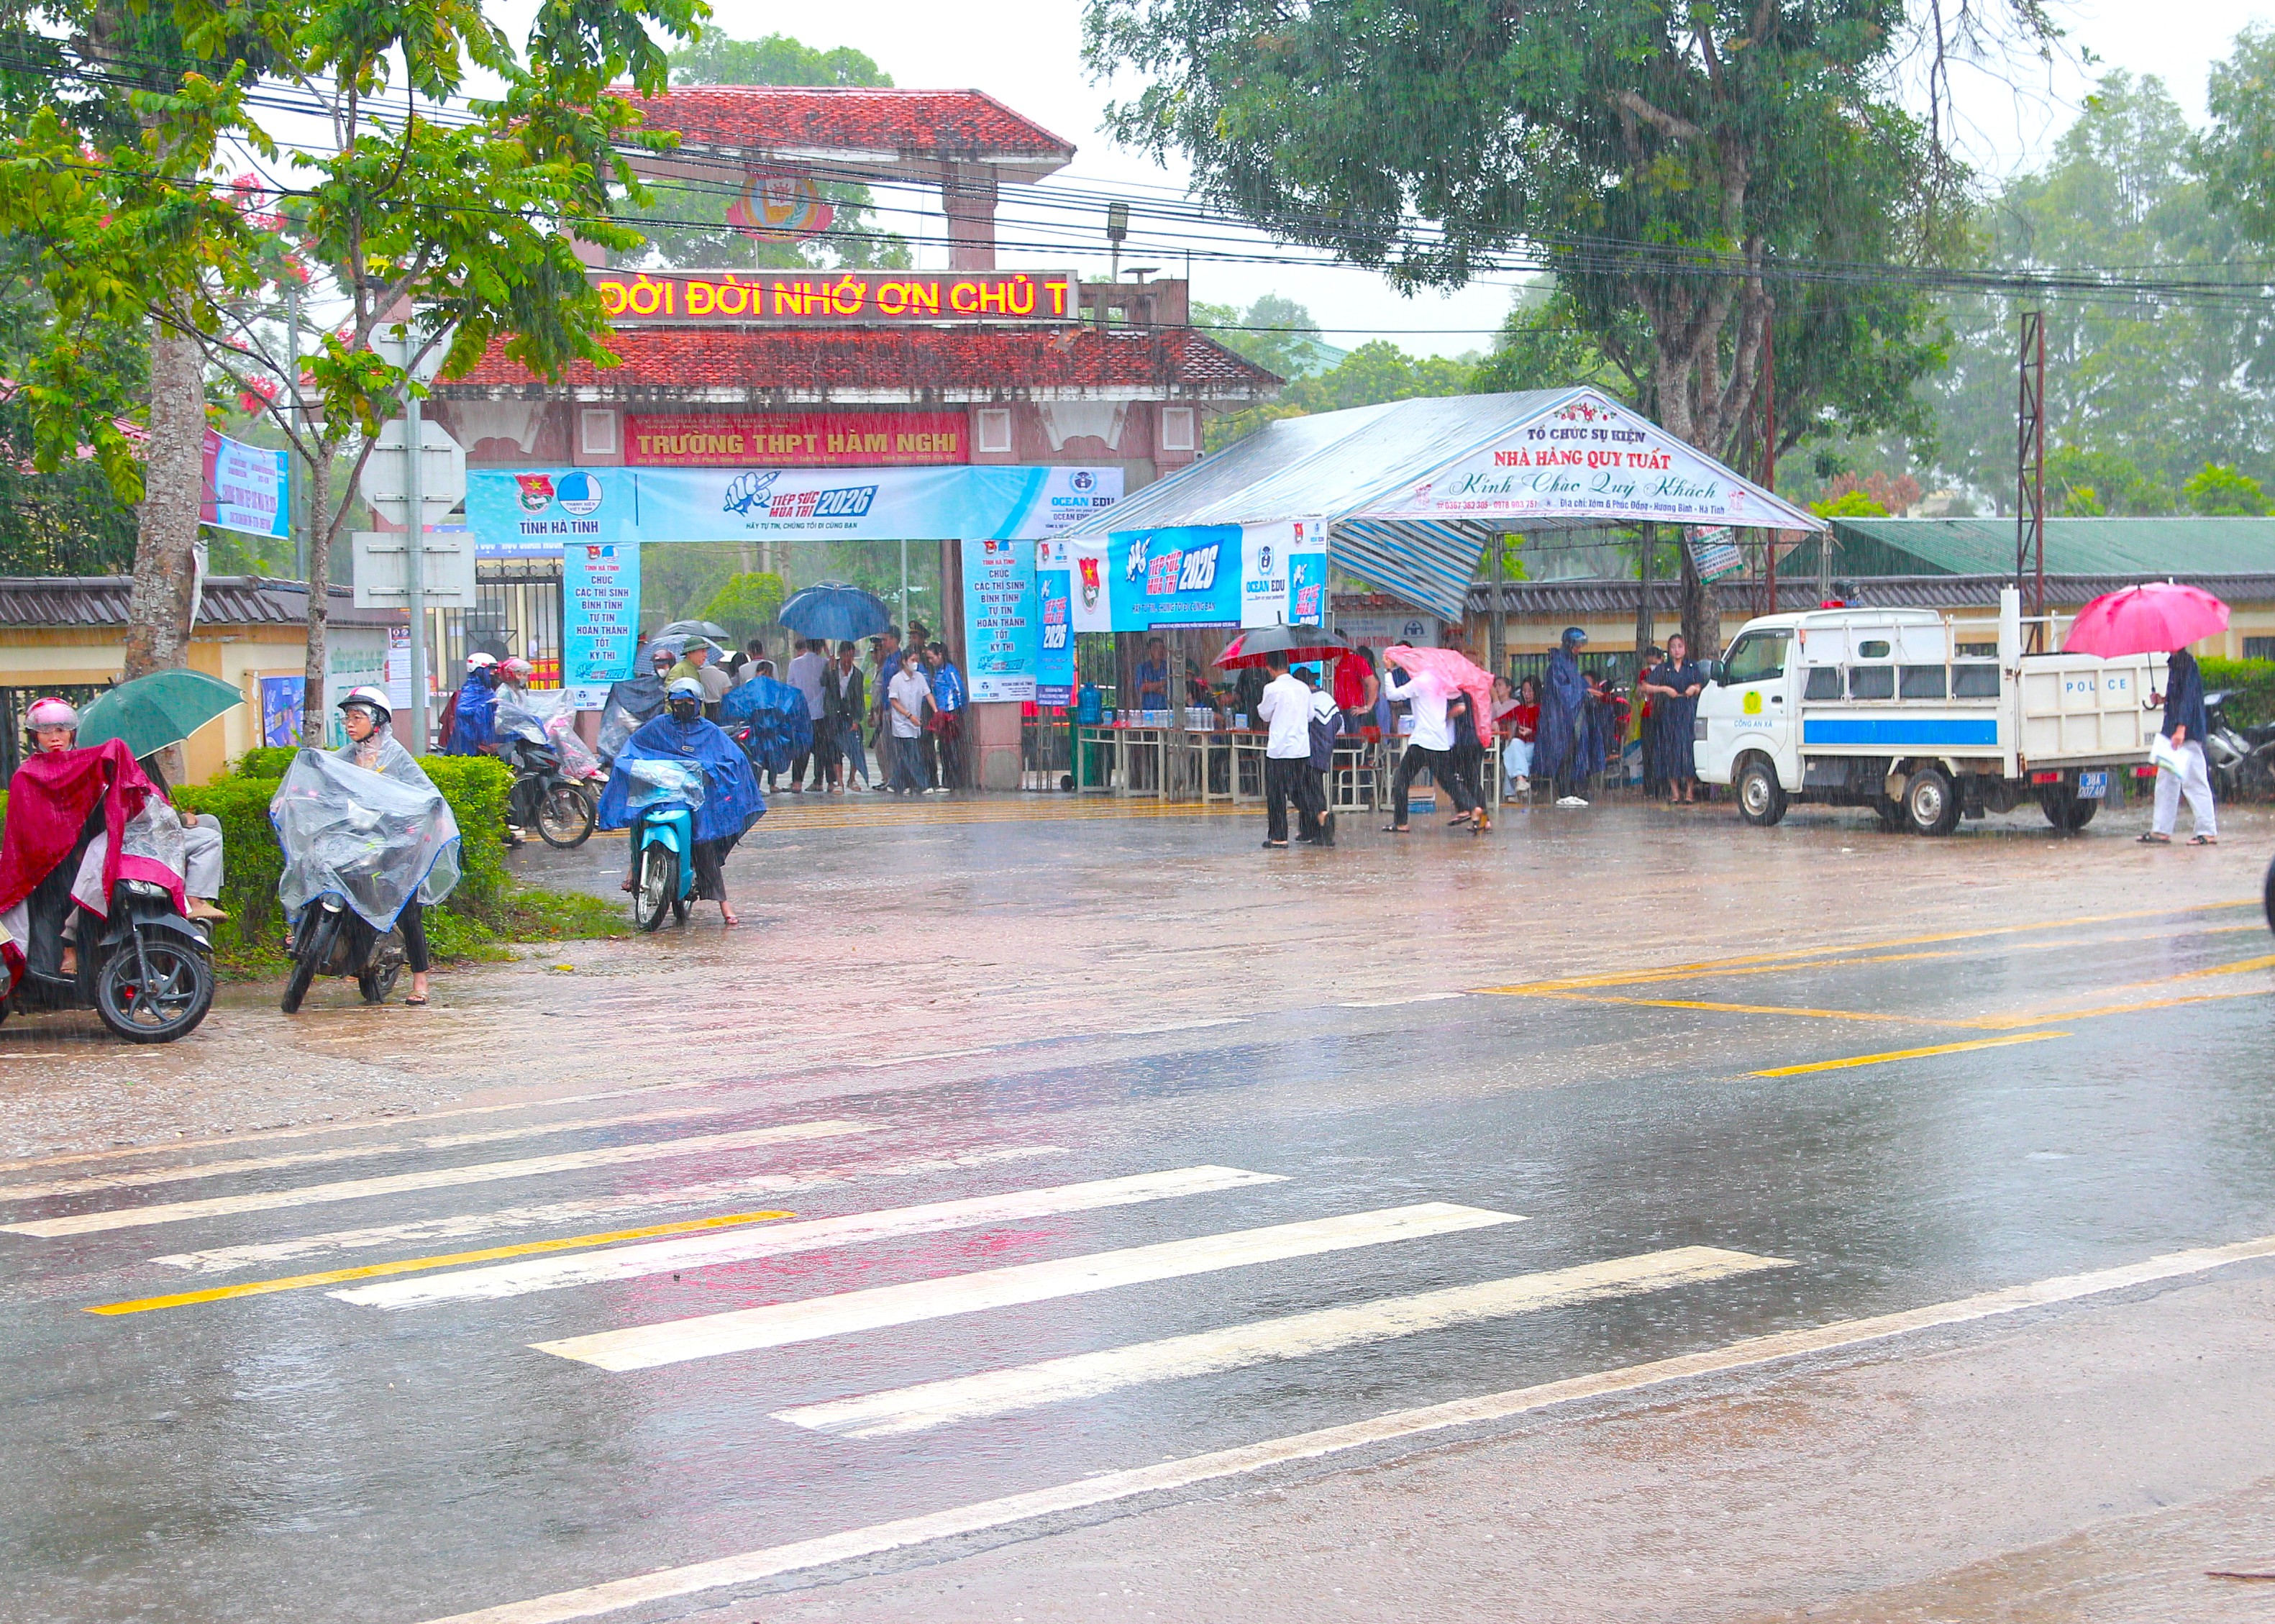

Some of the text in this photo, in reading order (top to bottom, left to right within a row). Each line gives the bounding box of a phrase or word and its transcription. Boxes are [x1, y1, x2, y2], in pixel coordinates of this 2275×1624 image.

[685, 273, 761, 315] ĐỜI
[773, 273, 865, 315] NHỚ
[877, 280, 939, 315] ƠN
[949, 273, 1035, 315] CHỦ
[1044, 281, 1068, 315] T
[1528, 424, 1646, 444] TỔ CHỨC SỰ KIỆN
[637, 429, 957, 455] TRƯỜNG THPT HÀM NGHI
[1494, 446, 1671, 469] NHÀ HÀNG QUY TUẤT
[1449, 471, 1719, 499] Kính Chào Quý Khách
[798, 490, 821, 505] SỨC
[816, 487, 873, 515] 2026
[1052, 497, 1088, 506] OCEAN
[795, 505, 814, 517] THI
[519, 518, 599, 534] TỈNH HÀ TĨNH
[1179, 544, 1219, 590] 2026
[591, 574, 613, 584] CHÚC
[989, 569, 1009, 578] CHÚC
[975, 581, 990, 590] CÁC
[1246, 579, 1285, 593] OCEAN EDU
[575, 588, 592, 596] CÁC
[594, 588, 606, 596] THÍ
[981, 593, 999, 603] BÌNH
[582, 600, 601, 609] BÌNH
[989, 606, 998, 616] TỰ
[589, 613, 601, 624] TỰ
[977, 618, 998, 627] HOÀN
[576, 625, 628, 634] HOÀN THÀNH
[995, 629, 1008, 639] TỐT
[596, 637, 610, 647] TỐT
[1043, 624, 1067, 648] 2026
[2066, 679, 2126, 692] POLCE
[2086, 773, 2101, 785] 38A
